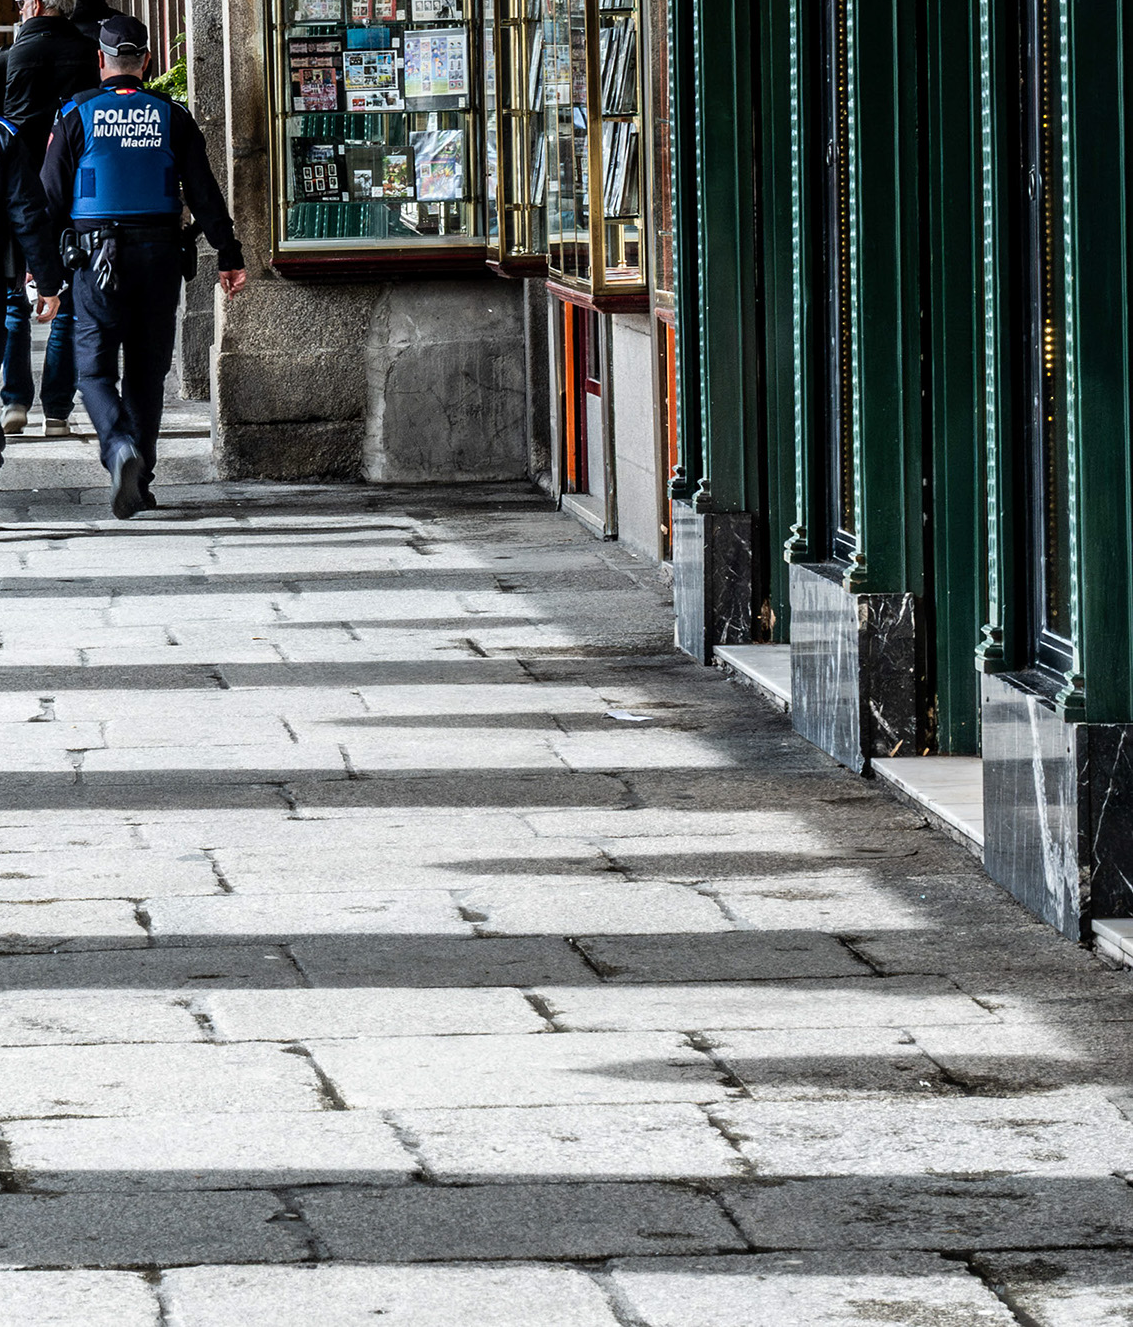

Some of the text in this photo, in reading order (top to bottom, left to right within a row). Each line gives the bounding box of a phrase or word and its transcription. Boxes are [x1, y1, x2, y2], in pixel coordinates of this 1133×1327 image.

[93, 104, 161, 124] POLICÍA
[93, 124, 162, 137] MUNICIPAL
[121, 137, 162, 148] Madrid
